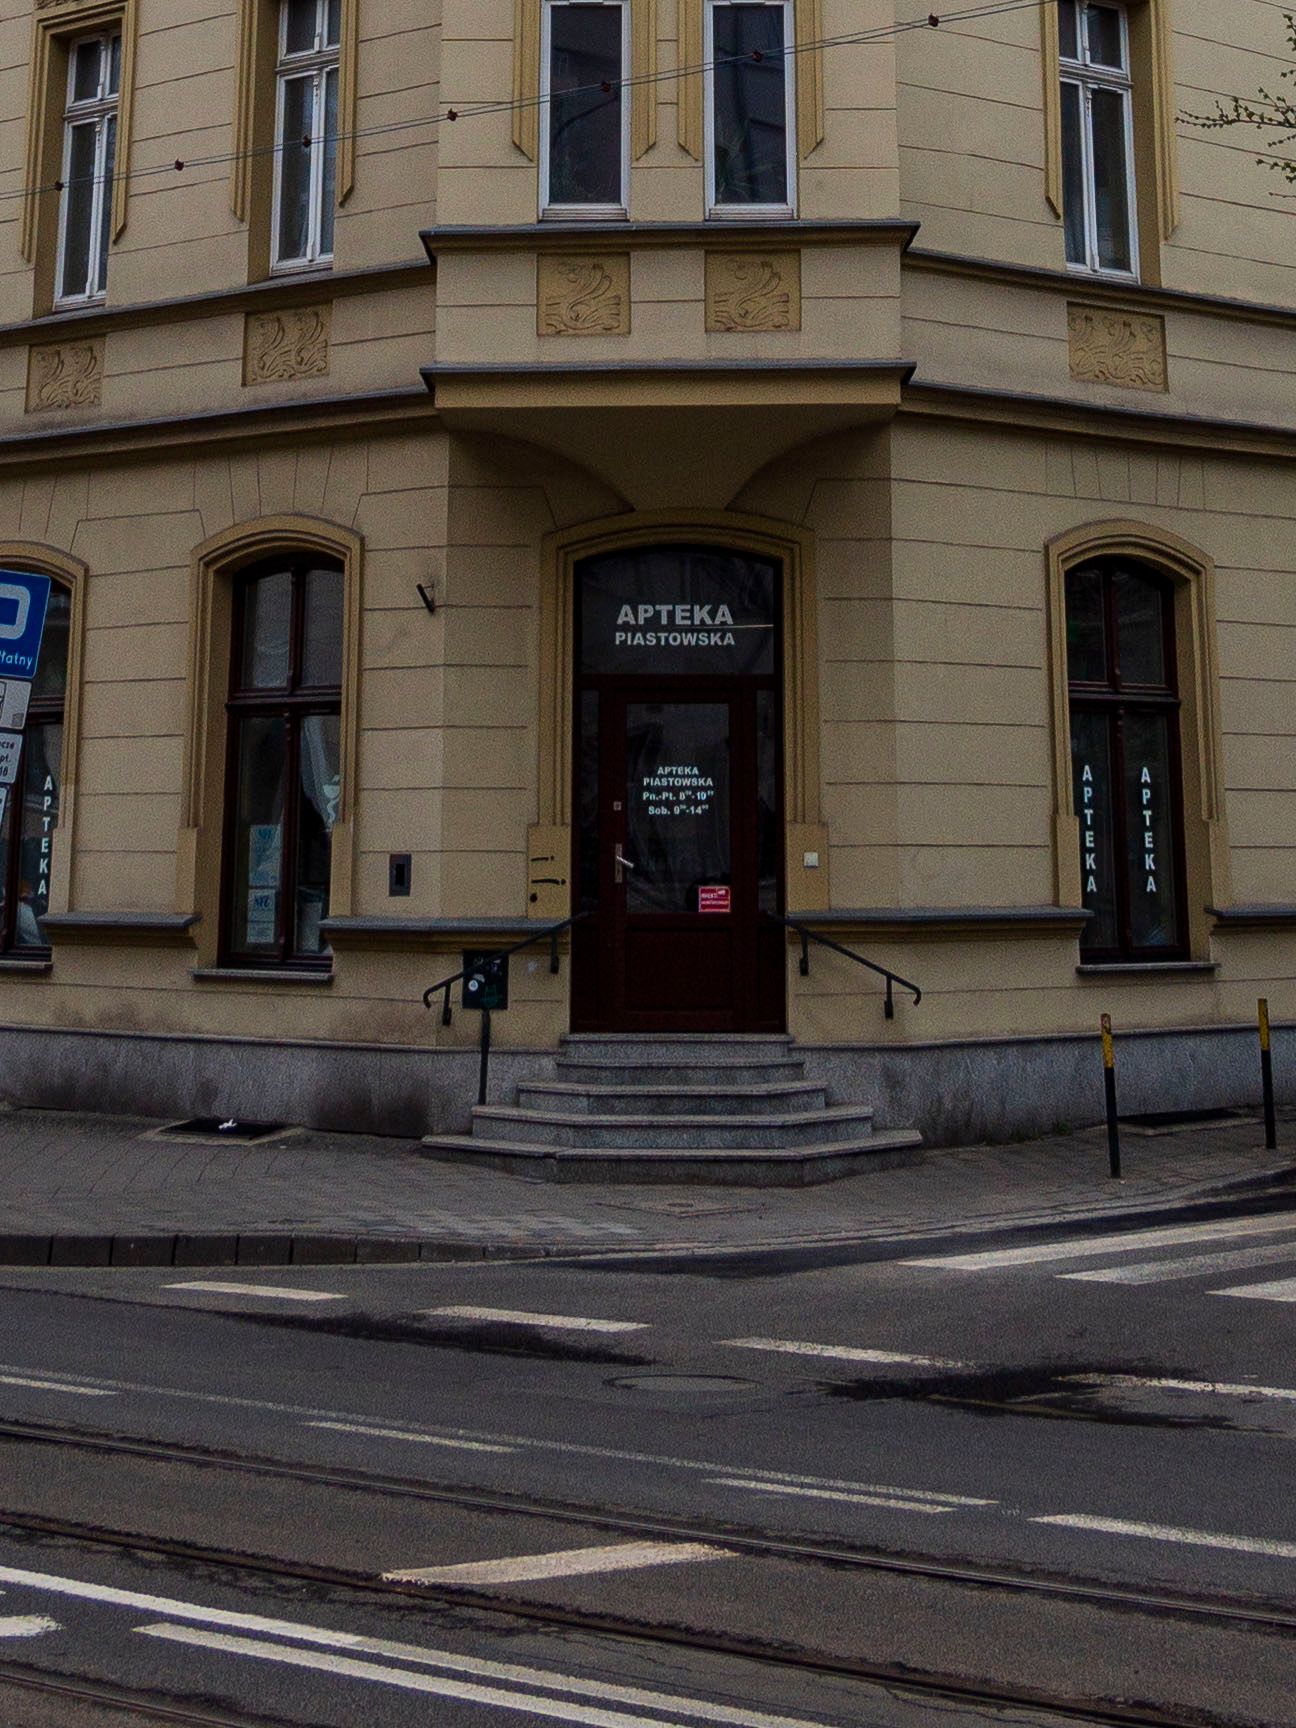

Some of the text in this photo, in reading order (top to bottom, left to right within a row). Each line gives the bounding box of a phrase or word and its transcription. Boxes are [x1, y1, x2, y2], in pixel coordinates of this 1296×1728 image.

[616, 604, 734, 625] APTEKA
[615, 632, 736, 646] PIASTOWSKA
[657, 766, 699, 775] APTEKA
[643, 777, 713, 786] PIASTOWSKA
[37, 775, 53, 895] APTEKA
[1082, 764, 1097, 893] APTEKA
[1141, 767, 1157, 892] APTEKA
